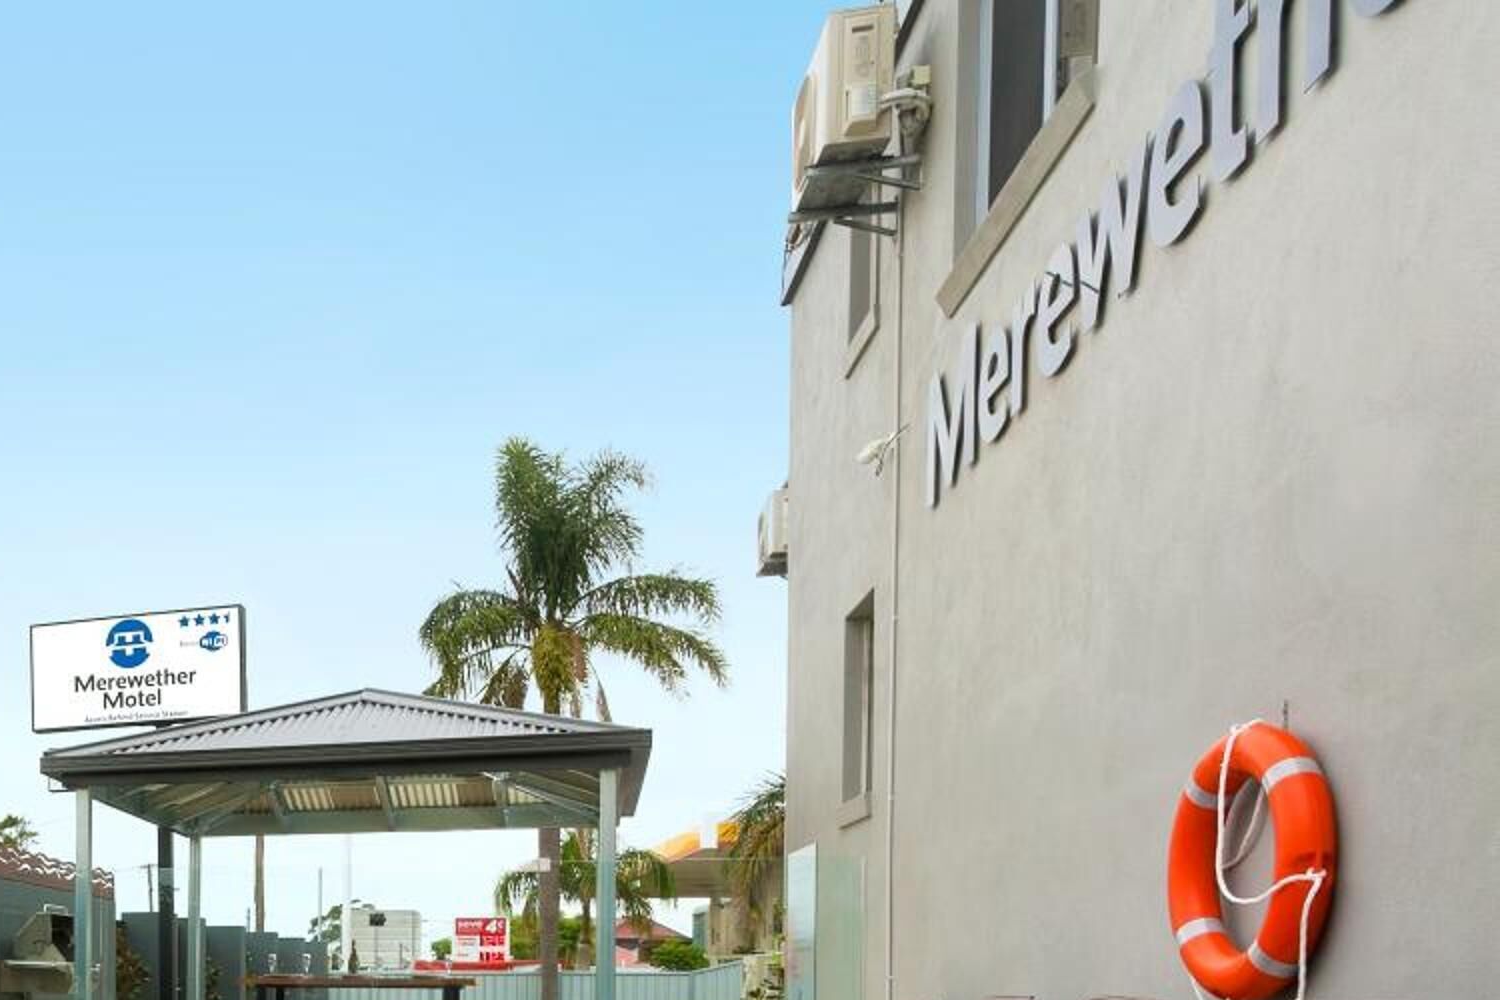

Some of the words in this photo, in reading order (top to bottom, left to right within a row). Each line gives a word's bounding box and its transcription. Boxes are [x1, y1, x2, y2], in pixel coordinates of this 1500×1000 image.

[924, 0, 1402, 507] Mereweth
[74, 668, 197, 693] Merewether
[103, 688, 161, 709] Motel
